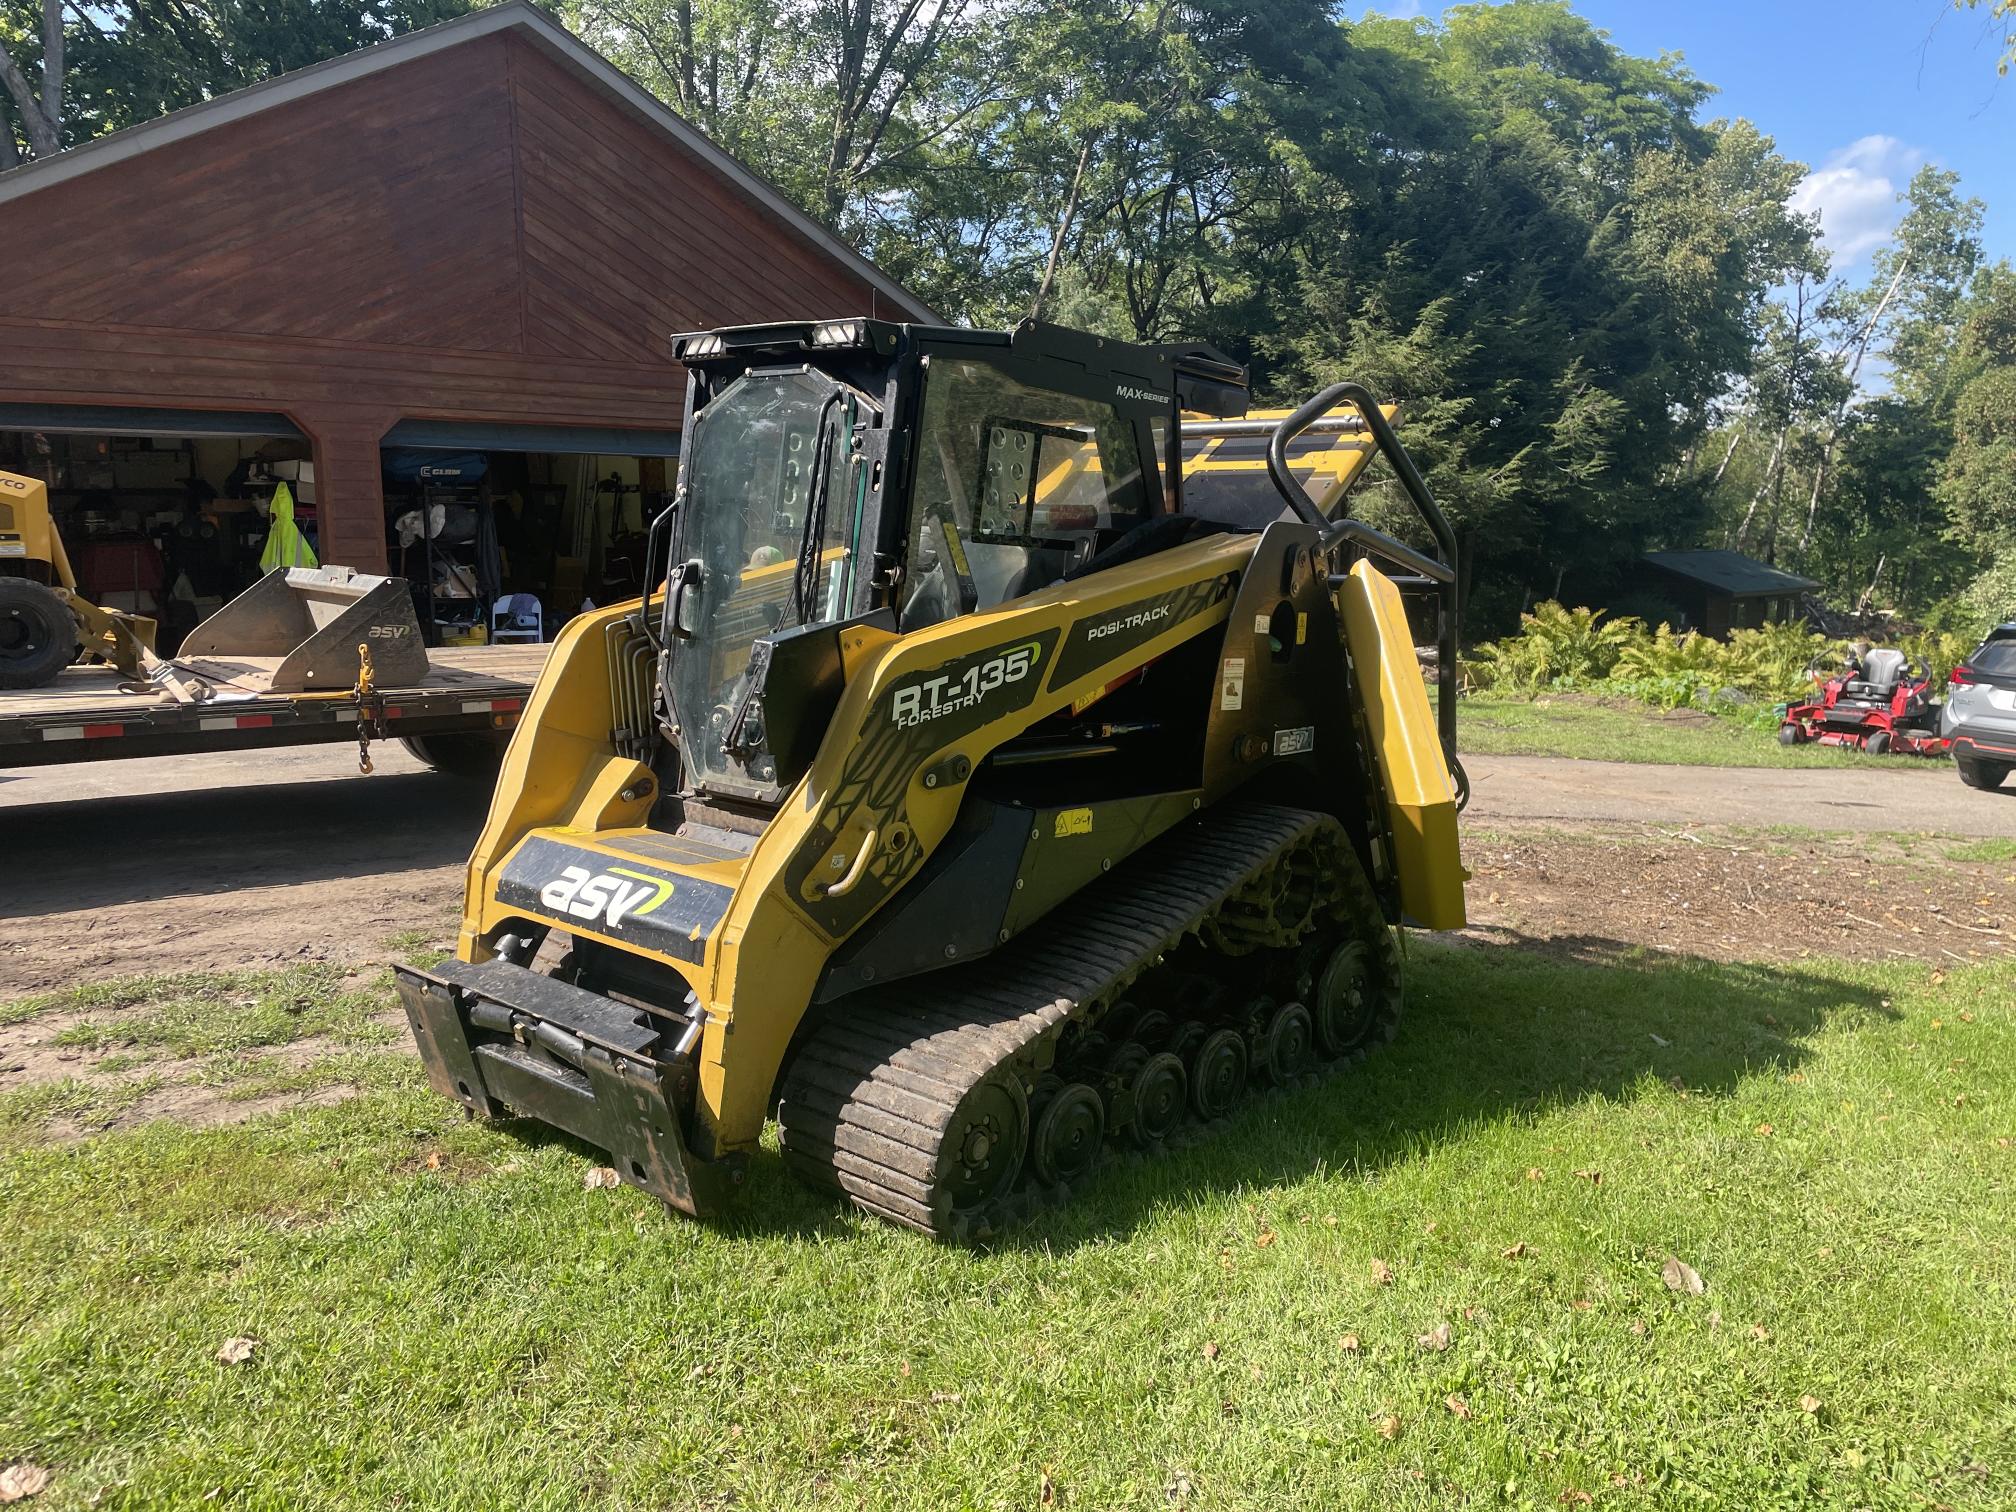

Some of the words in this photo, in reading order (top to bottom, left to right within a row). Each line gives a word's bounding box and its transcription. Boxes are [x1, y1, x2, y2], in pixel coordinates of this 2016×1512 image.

[0, 477, 26, 489] CO
[1087, 604, 1170, 641] POSI-TRACK
[891, 650, 1030, 721] RT-135
[897, 690, 987, 730] FORESTRY
